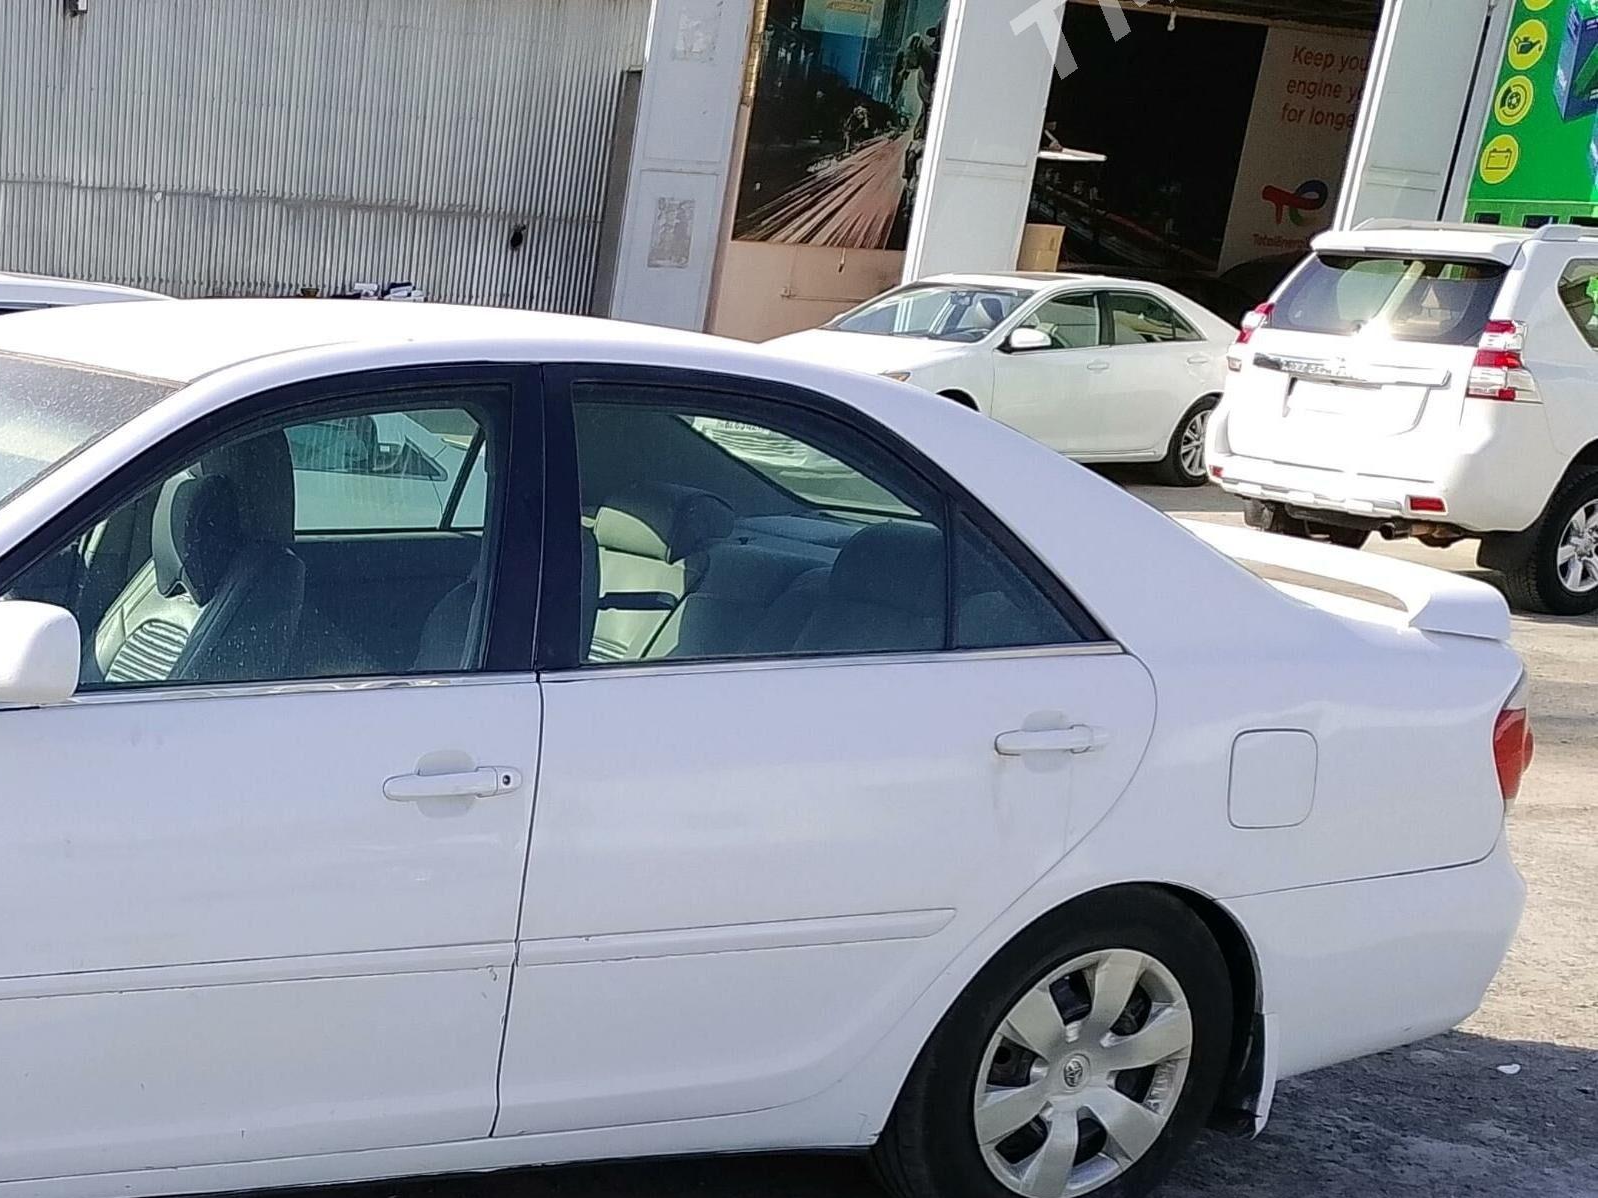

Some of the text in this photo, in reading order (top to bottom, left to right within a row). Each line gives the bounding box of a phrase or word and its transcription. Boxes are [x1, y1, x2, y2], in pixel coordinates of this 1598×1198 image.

[1292, 45, 1335, 72] Keep
[1286, 78, 1342, 99] engine
[1281, 103, 1306, 123] for
